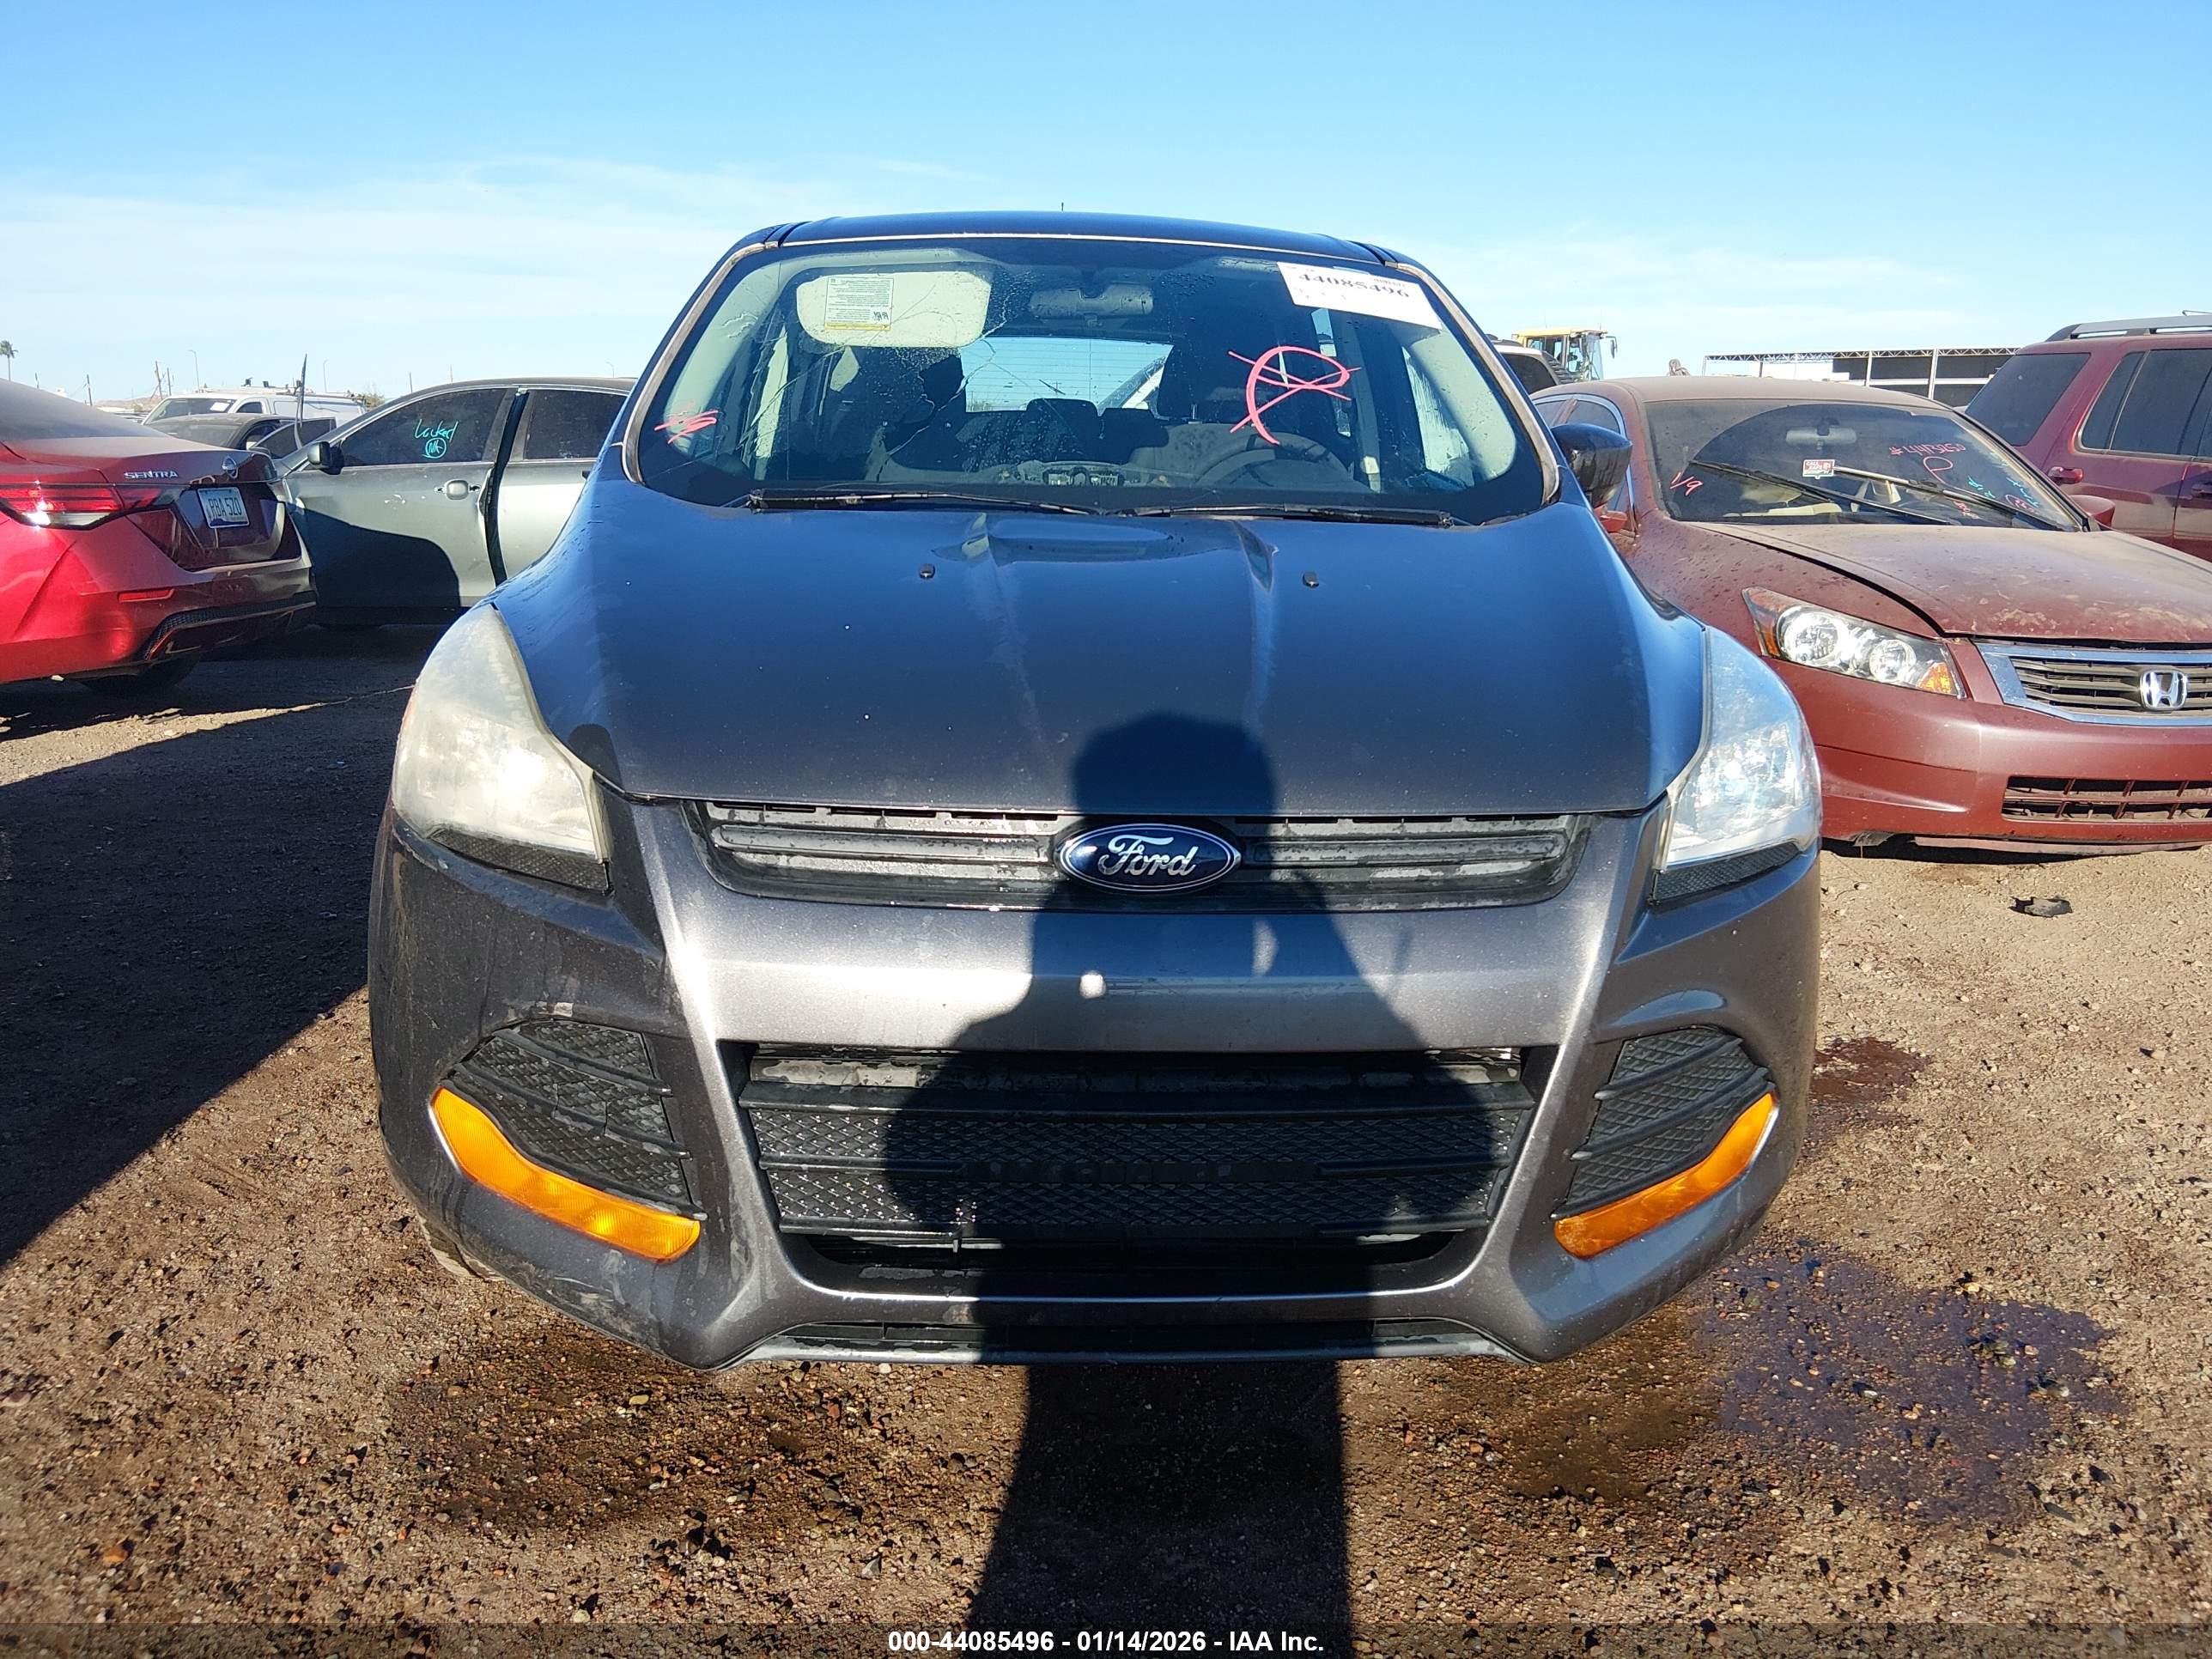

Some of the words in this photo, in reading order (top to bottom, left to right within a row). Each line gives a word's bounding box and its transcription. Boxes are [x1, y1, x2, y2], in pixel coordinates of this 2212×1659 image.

[1298, 273, 1410, 298] 44085496
[124, 470, 179, 480] SENTRA
[1097, 834, 1200, 876] Ford
